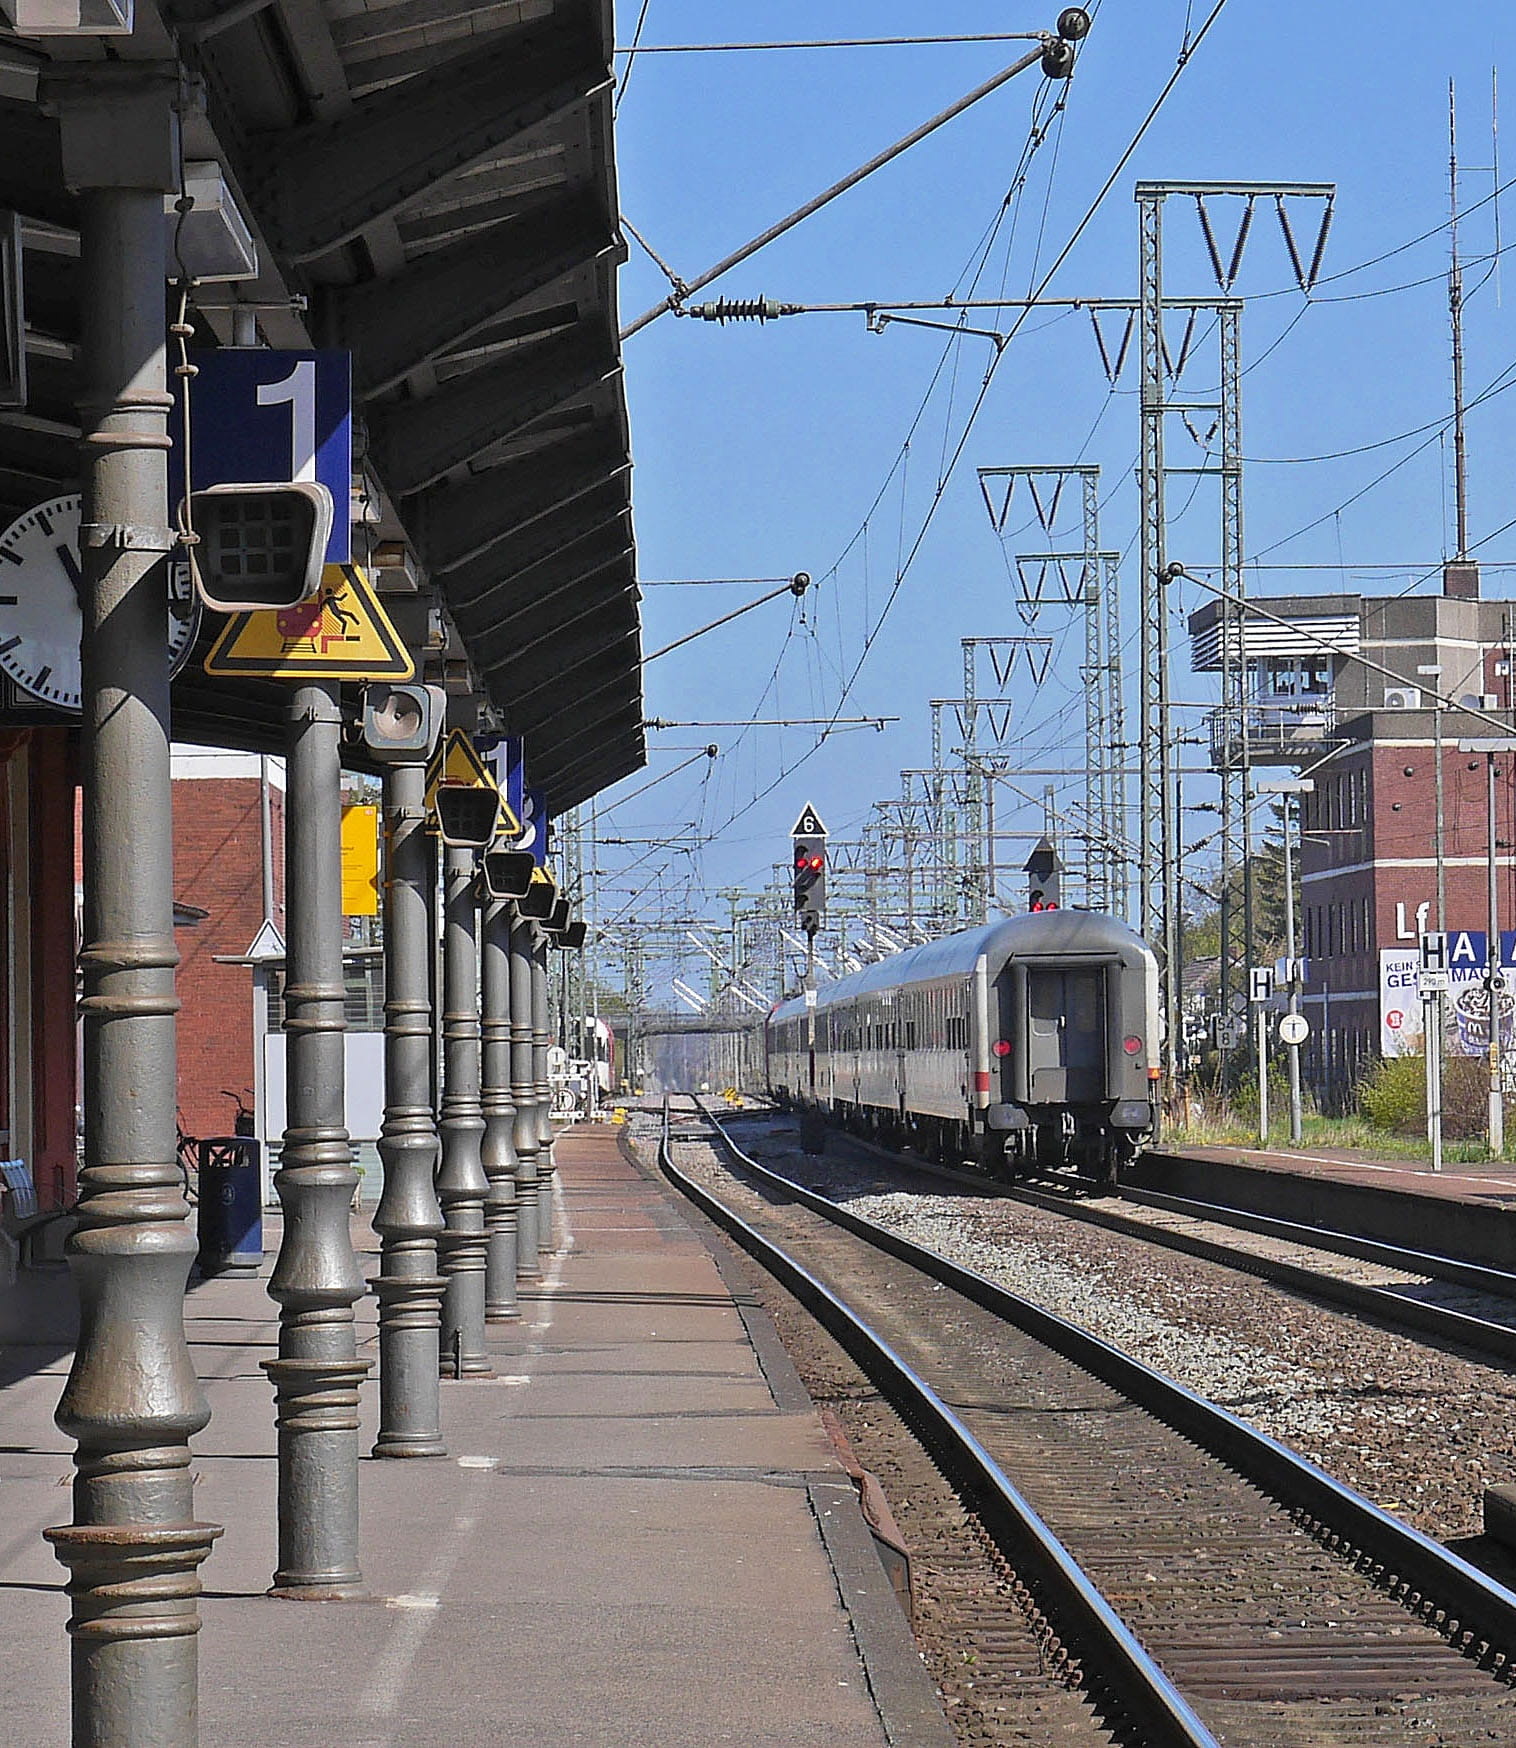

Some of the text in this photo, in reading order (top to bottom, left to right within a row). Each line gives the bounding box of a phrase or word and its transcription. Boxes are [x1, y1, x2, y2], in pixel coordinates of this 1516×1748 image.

[256, 361, 317, 483] 1
[480, 741, 509, 803] 1
[803, 816, 815, 832] 6
[1423, 935, 1444, 969] H
[1451, 932, 1477, 962] A
[1386, 962, 1413, 972] KEIN
[1253, 970, 1271, 999] H
